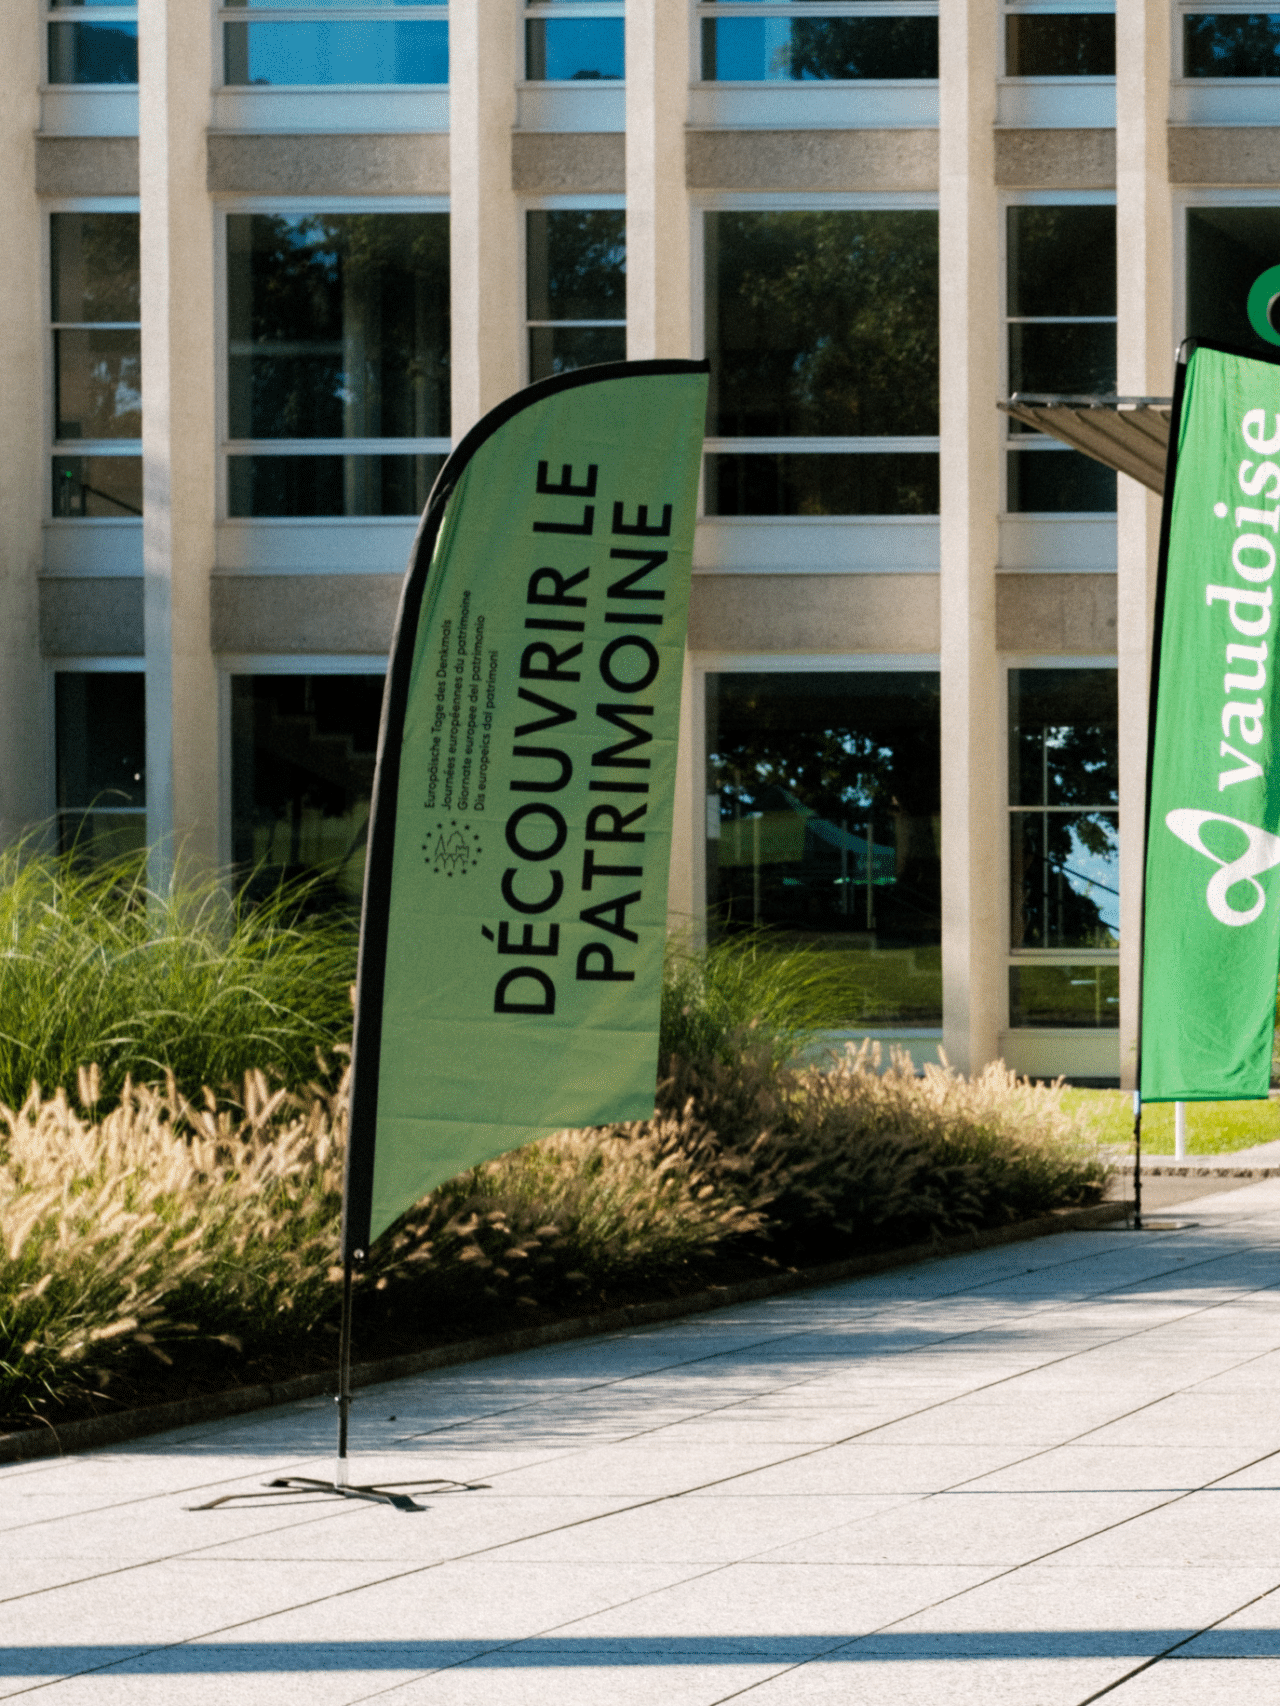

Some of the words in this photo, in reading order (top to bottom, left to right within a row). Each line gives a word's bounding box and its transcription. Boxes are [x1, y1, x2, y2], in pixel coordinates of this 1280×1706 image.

[532, 460, 598, 536] LE
[436, 618, 452, 679] Denkmals
[457, 590, 472, 657] patrimoine
[472, 614, 486, 682] patrimonio
[436, 680, 446, 703] des
[456, 658, 465, 675] du
[469, 683, 479, 704] del
[486, 650, 499, 710] patrimoni
[431, 703, 447, 735] Tage
[449, 675, 464, 755] européennes
[465, 705, 478, 755] europee
[482, 710, 493, 731] dal
[575, 500, 673, 982] PATRIMOINE
[424, 736, 442, 809] Europäische
[441, 756, 456, 811] Journées
[457, 756, 472, 811] Giornate
[478, 733, 491, 793] europeics
[481, 566, 590, 1016] DÉCOUVRIR
[474, 792, 485, 812] Dis
